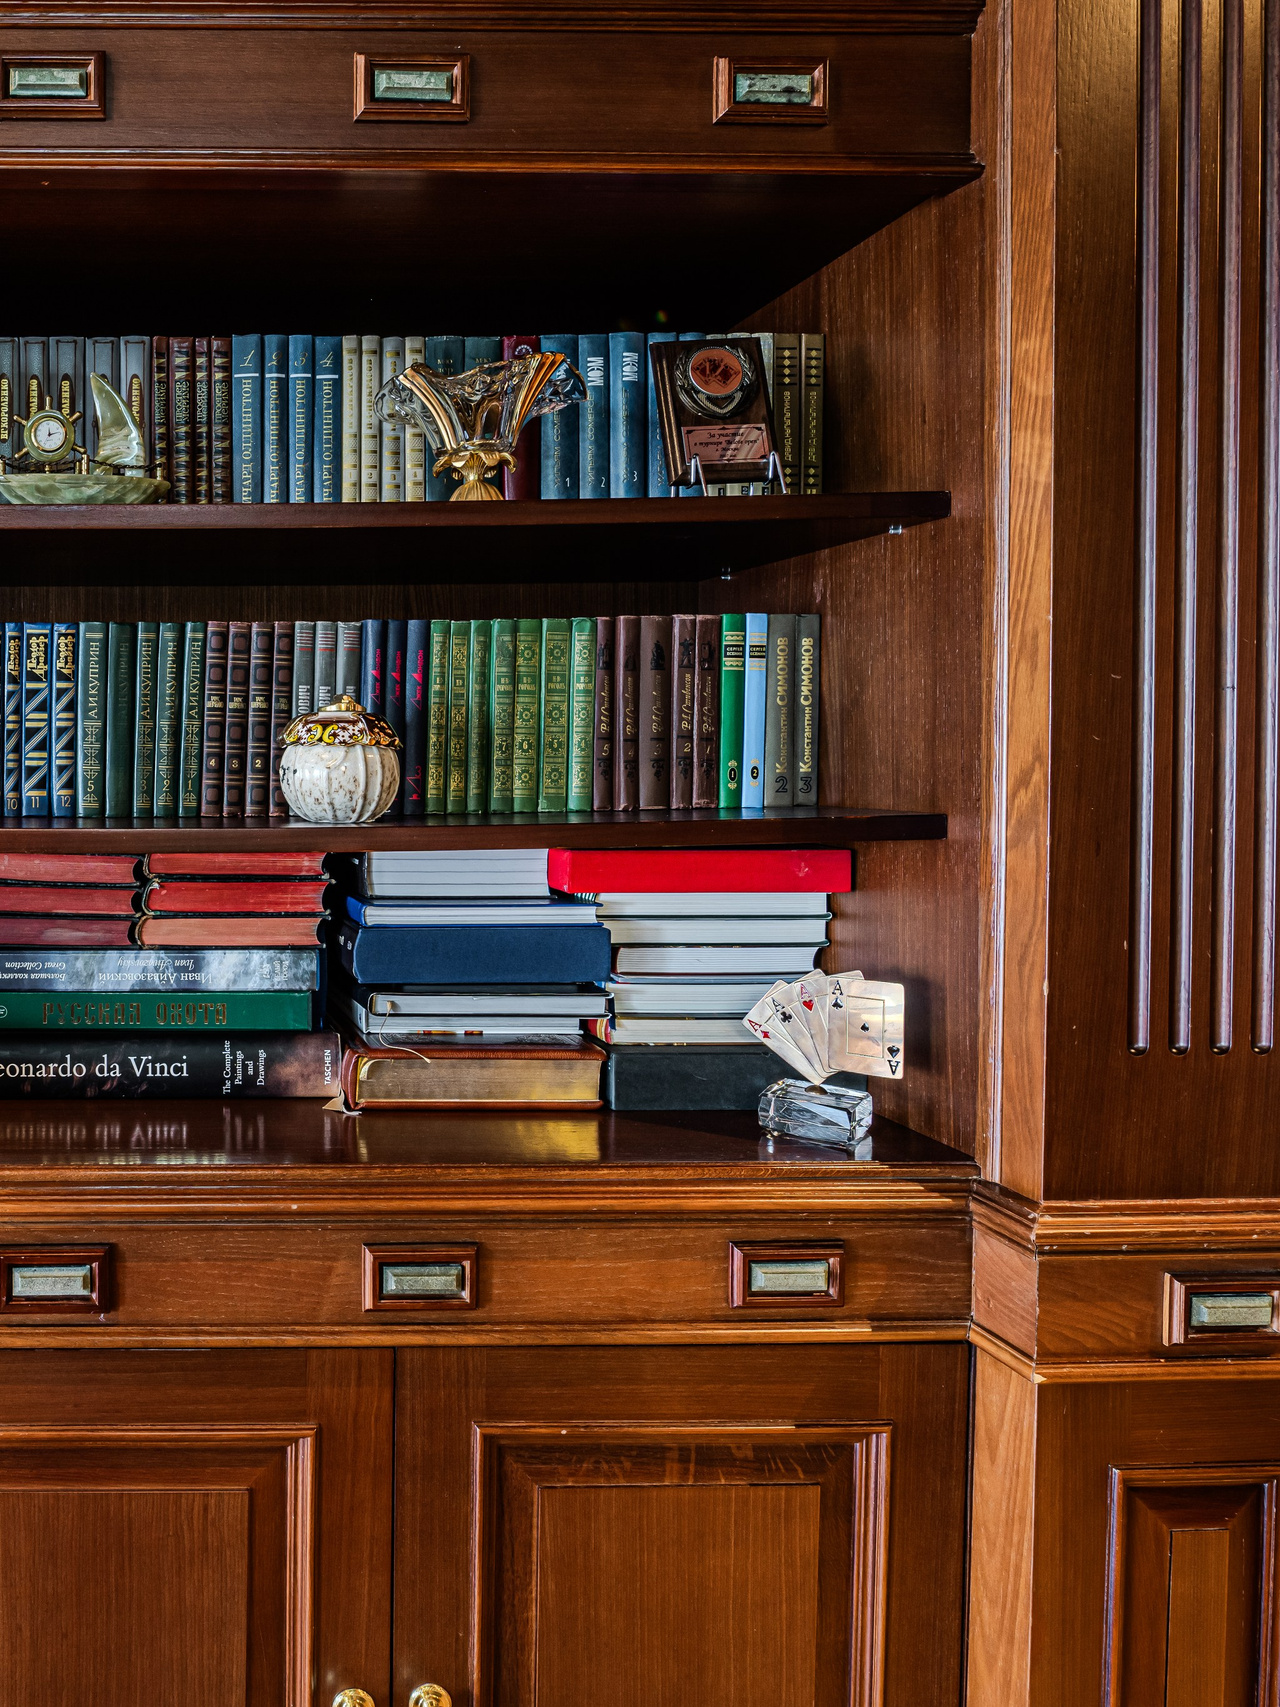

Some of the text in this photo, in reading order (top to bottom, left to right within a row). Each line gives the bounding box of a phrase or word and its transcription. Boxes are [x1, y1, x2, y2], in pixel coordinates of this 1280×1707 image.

[239, 349, 255, 367] 1
[267, 351, 283, 367] 2
[294, 351, 309, 367] 3
[319, 351, 334, 368] 4
[241, 378, 254, 460] ОЛДИНГТОН
[322, 380, 334, 461] ОЛДИНГТОН
[600, 476, 606, 488] 2
[633, 470, 638, 482] 3
[684, 744, 691, 752] 2
[799, 706, 813, 773] Константин
[87, 780, 95, 792] 5
[163, 780, 170, 791] 2
[775, 776, 789, 793] 2
[799, 776, 812, 793] 3
[31, 797, 40, 808] 11
[61, 796, 71, 807] 12
[5, 961, 66, 970] Great Collection
[831, 980, 844, 997] A
[42, 1002, 228, 1025] РУССКАЯ ОХОТА
[771, 998, 785, 1013] A
[746, 1018, 762, 1033] A
[95, 1054, 122, 1078] da
[128, 1055, 189, 1078] Vinci
[222, 1040, 234, 1095] The Complete
[234, 1050, 245, 1085] Paintings
[256, 1049, 267, 1086] Drawings
[886, 1059, 901, 1076] A
